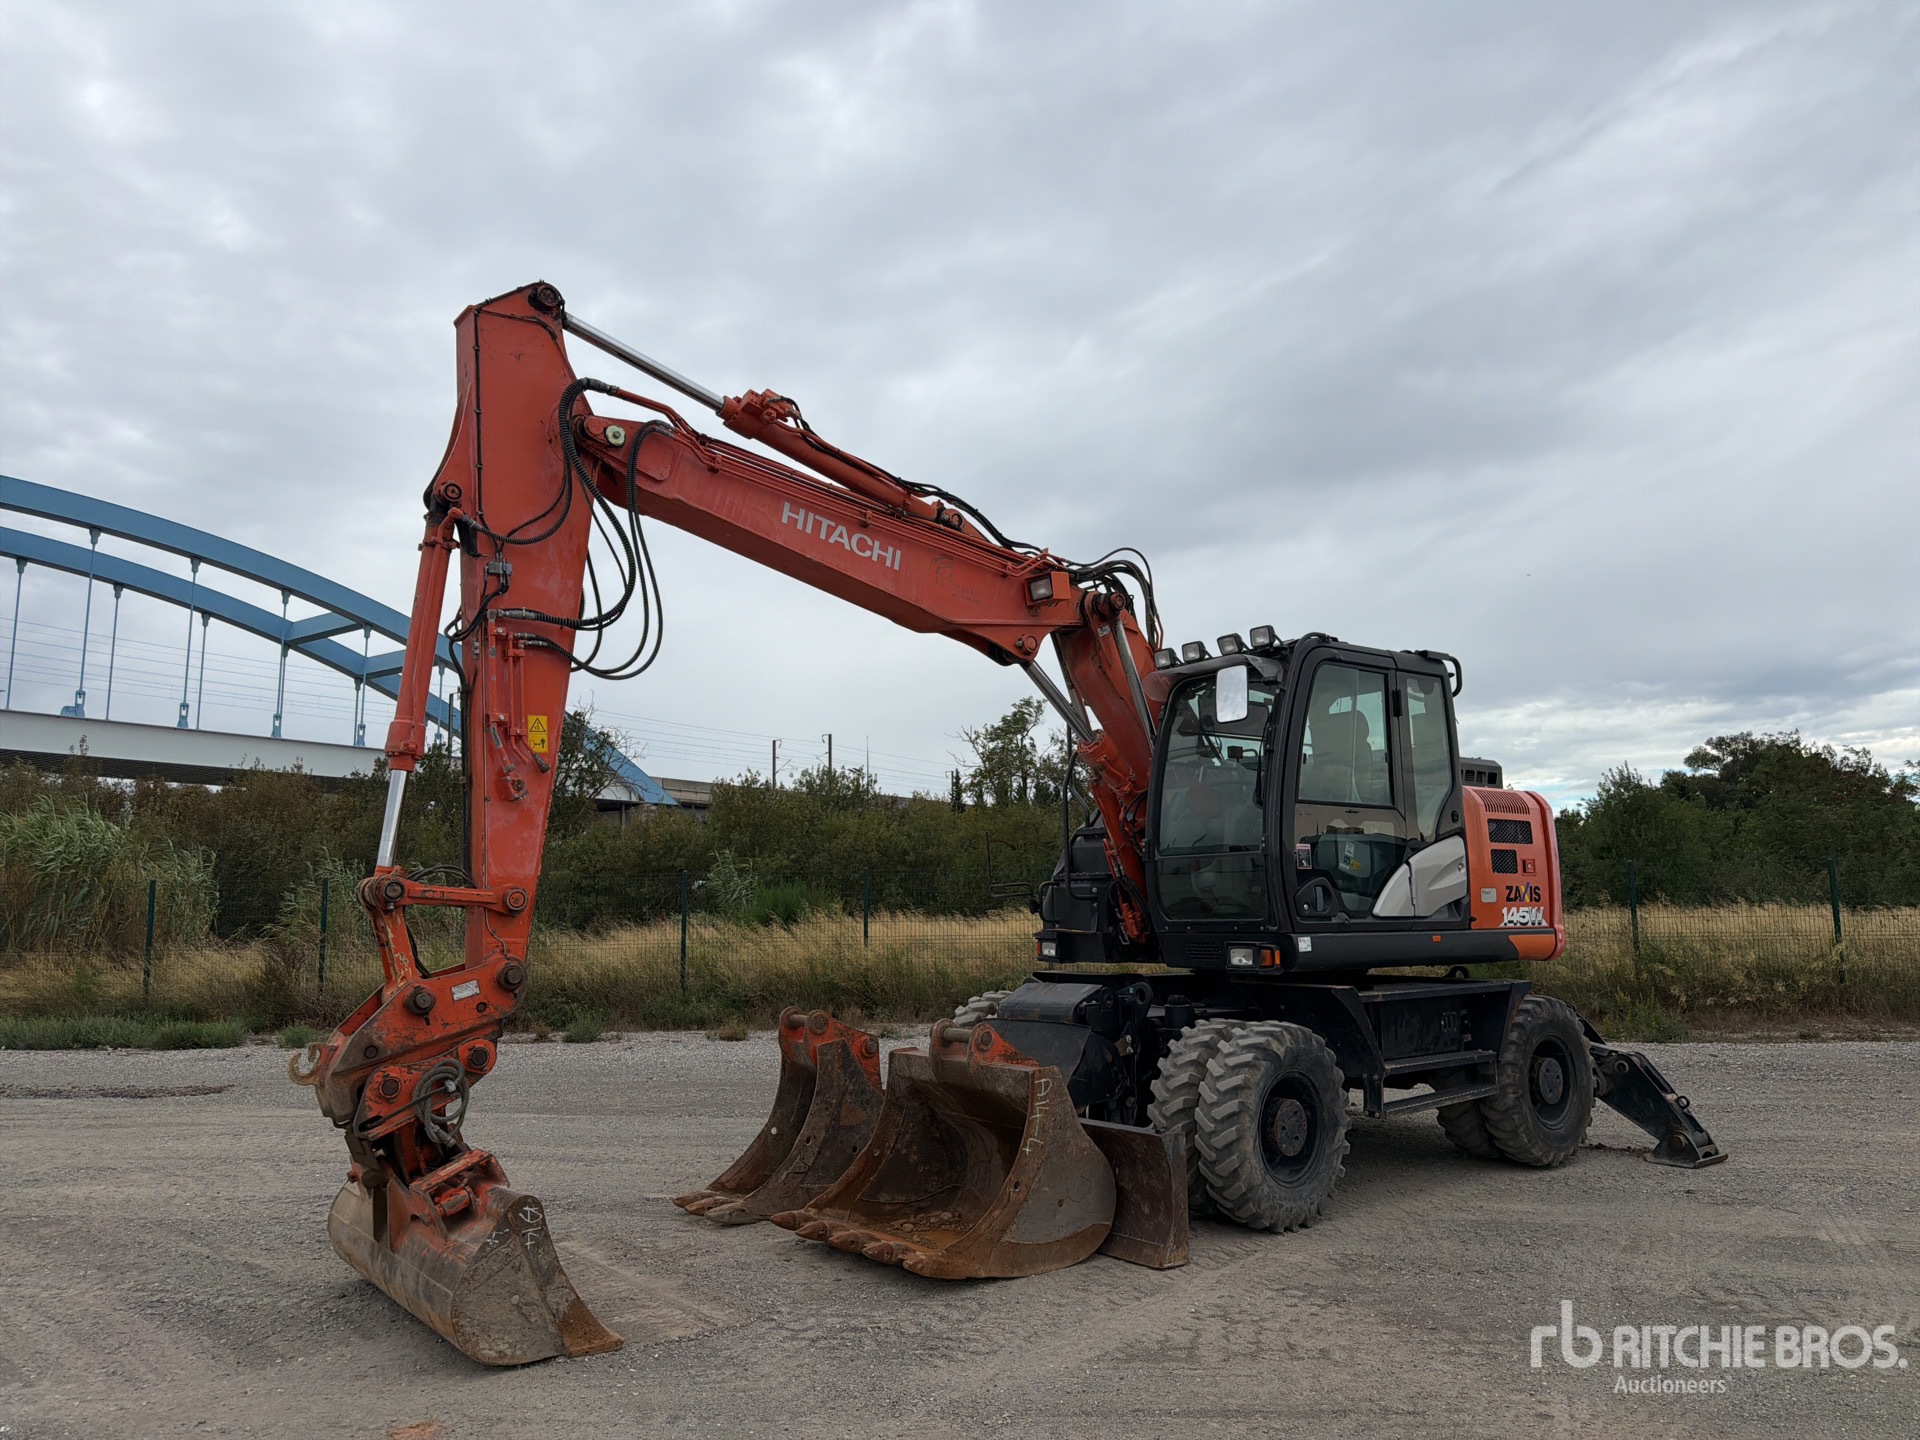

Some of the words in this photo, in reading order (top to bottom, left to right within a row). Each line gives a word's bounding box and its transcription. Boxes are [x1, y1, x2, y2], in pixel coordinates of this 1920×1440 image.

[781, 501, 902, 571] HITACHI
[1505, 882, 1541, 903] ZAXIS
[1501, 906, 1544, 926] 145W
